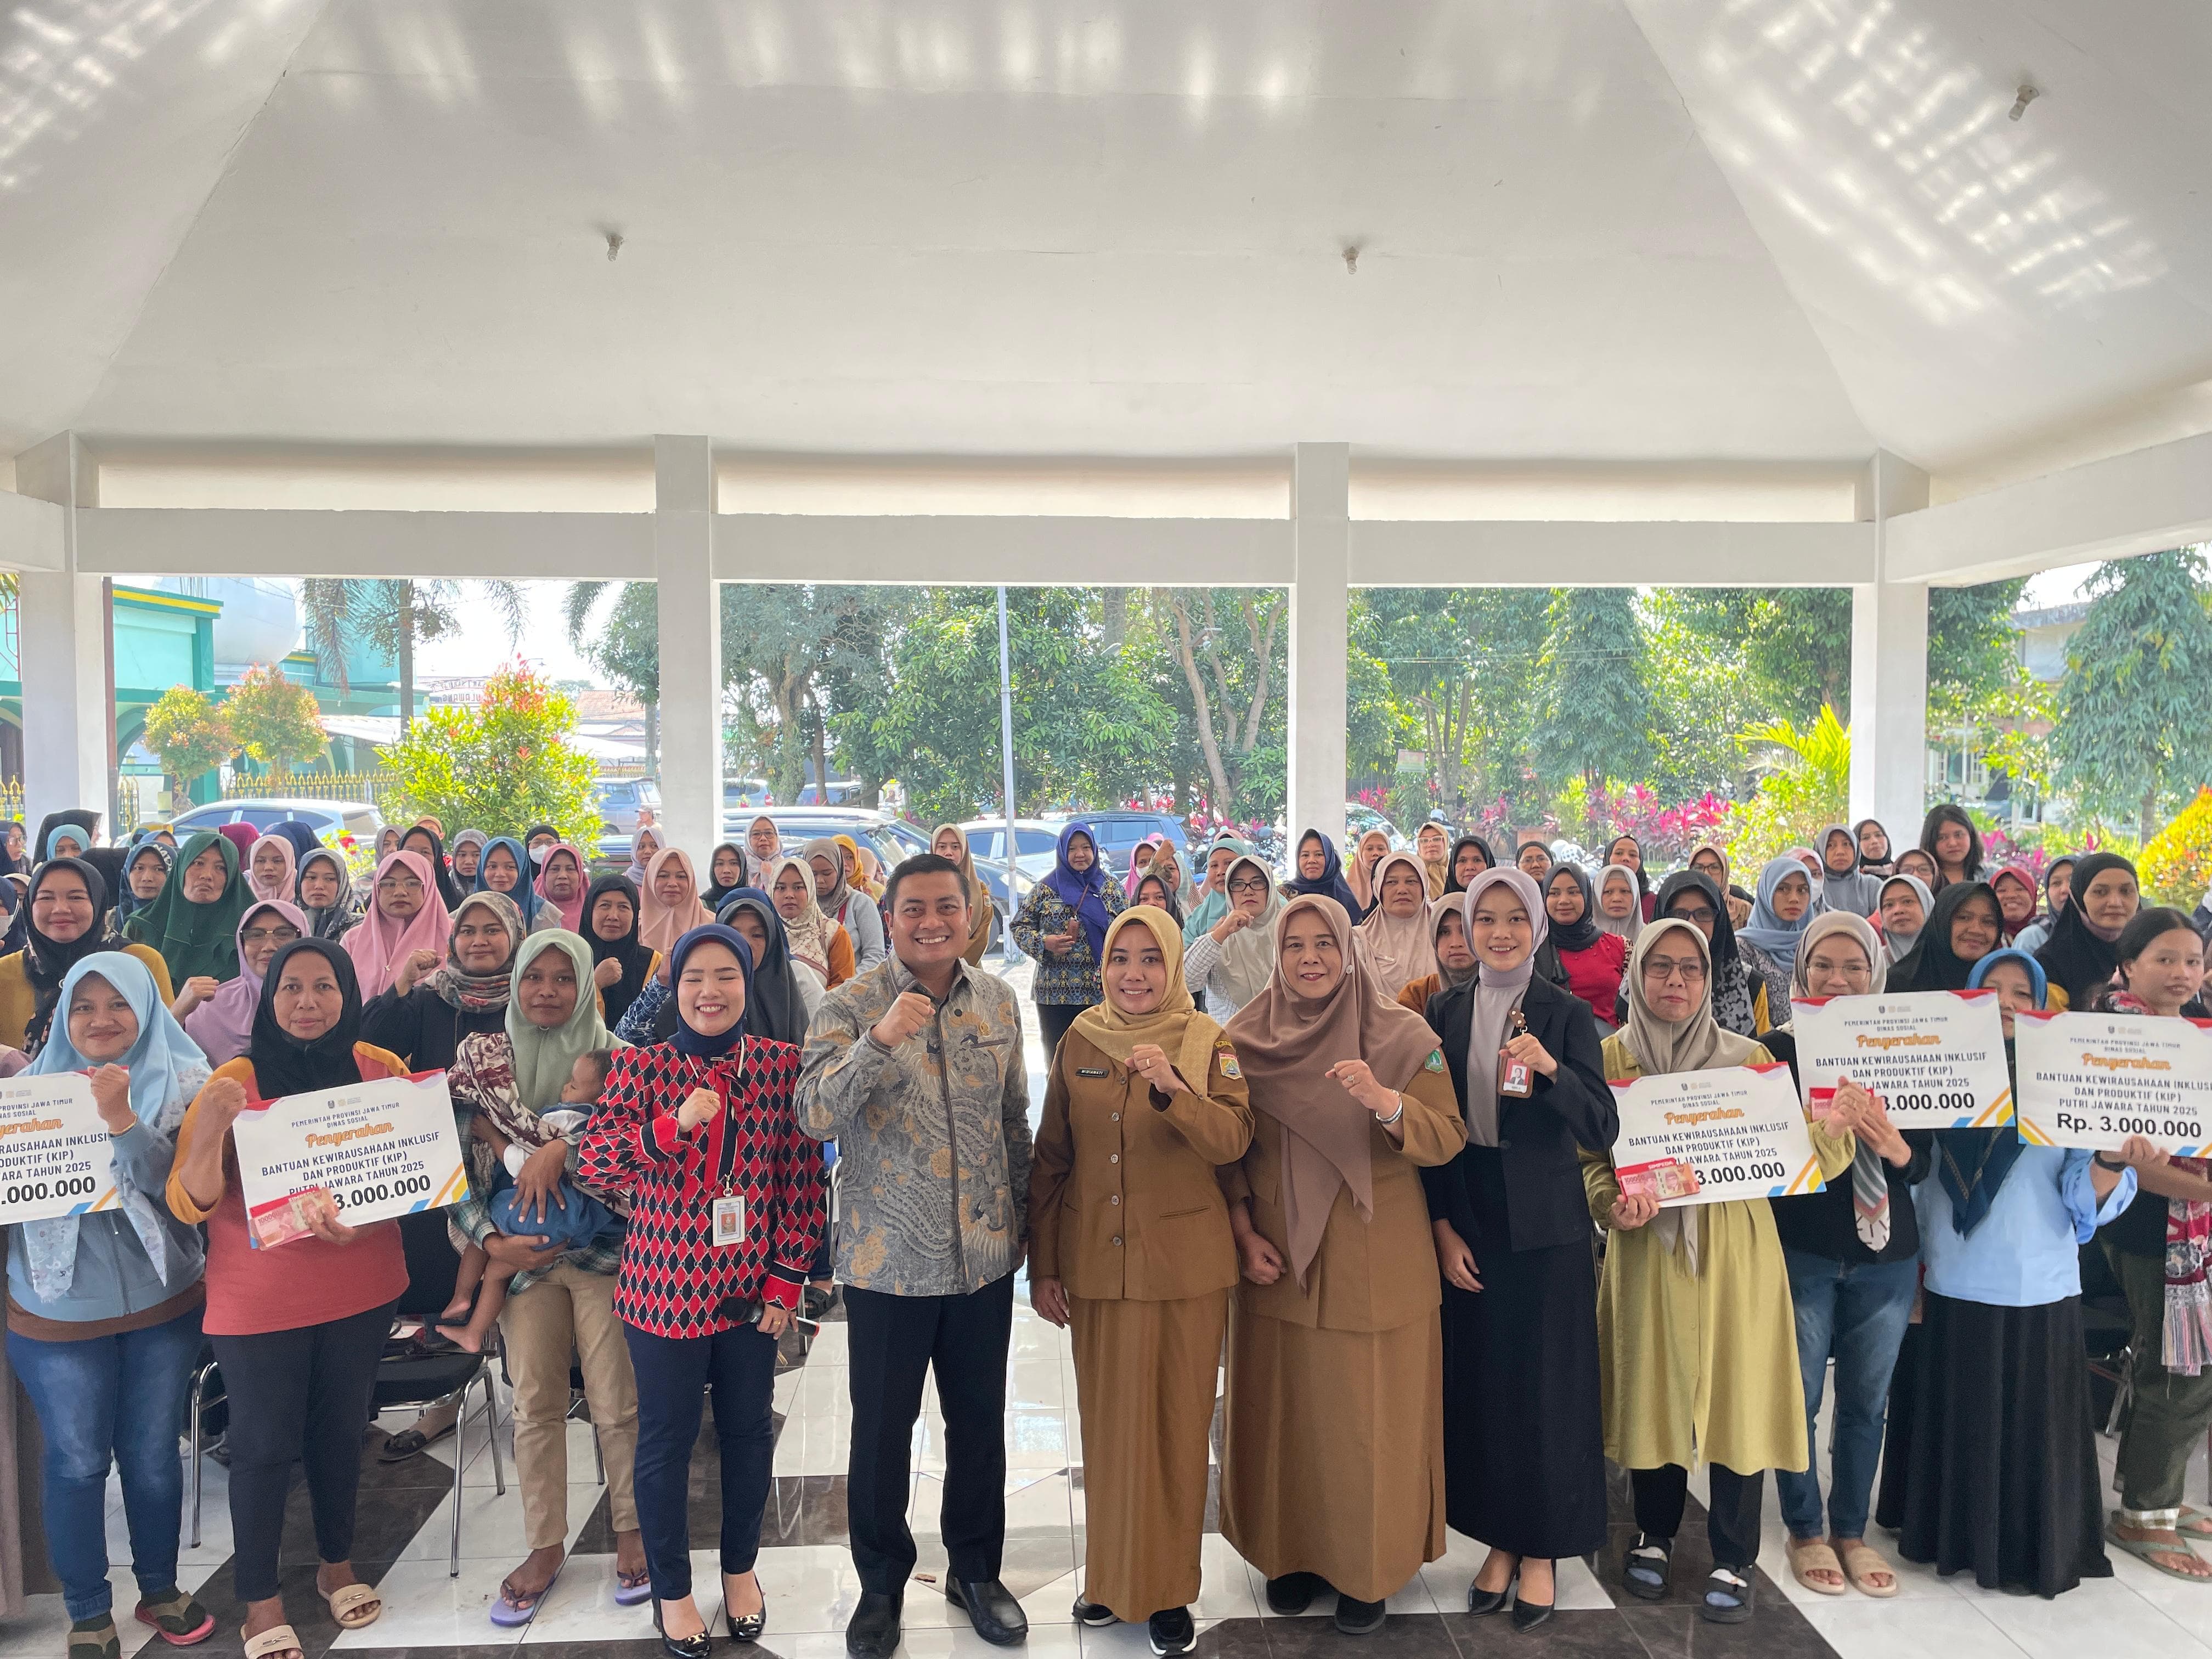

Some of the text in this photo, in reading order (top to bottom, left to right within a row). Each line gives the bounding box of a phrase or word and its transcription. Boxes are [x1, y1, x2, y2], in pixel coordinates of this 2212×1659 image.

[1856, 1033, 1941, 1050] Penyerahan
[1816, 1052, 1985, 1066] BANTUAN KEWIRAUSAHAAN INKLUSIF
[2081, 1053, 2171, 1071] Penyerahan
[1853, 1066, 1953, 1077] DAN PRODUKTIF (KIP)
[2036, 1073, 2081, 1082] BANTUAN
[2086, 1075, 2170, 1088] KEWIRAUSAHAAN
[1869, 1080, 1908, 1090] JAWARA
[1912, 1079, 1943, 1088] TAHUN
[1946, 1078, 1969, 1087] 2025
[2075, 1087, 2181, 1102] DAN PRODUKTIF (KIP)
[292, 1115, 330, 1127] PEMERINTAH
[332, 1110, 360, 1120] PROVINSI
[381, 1102, 399, 1110] TIMUR
[2059, 1098, 2197, 1115] PUTRI JAWARA TAHUN 2025
[327, 1116, 368, 1128] DINAS SOSIAL
[1664, 1107, 1745, 1126] Penyerahan
[2057, 1113, 2201, 1137] Rp. 3.000.000
[305, 1122, 394, 1148] Penyerahan
[1629, 1122, 1788, 1146] BANTUAN KEWIRAUSAHAAN INKLUSIF
[262, 1132, 439, 1176] BANTUAN KEWIRAUSAHAAN INKLUSIF
[1666, 1137, 1759, 1154] DAN PRODUKTIF (KIP)
[1723, 1150, 1753, 1161] TAHUN
[1755, 1148, 1777, 1158] 2025
[47, 1149, 74, 1163] (KIP)
[0, 1161, 91, 1181] ARA TAHUN 2025
[303, 1151, 407, 1181] DAN PRODUKTIF (KIP)
[366, 1166, 398, 1180] TAHUN
[401, 1161, 424, 1173] 2025
[1695, 1162, 1785, 1186] 3.000.000
[1, 1176, 95, 1205] .000.000
[332, 1175, 430, 1211] 3.000.000
